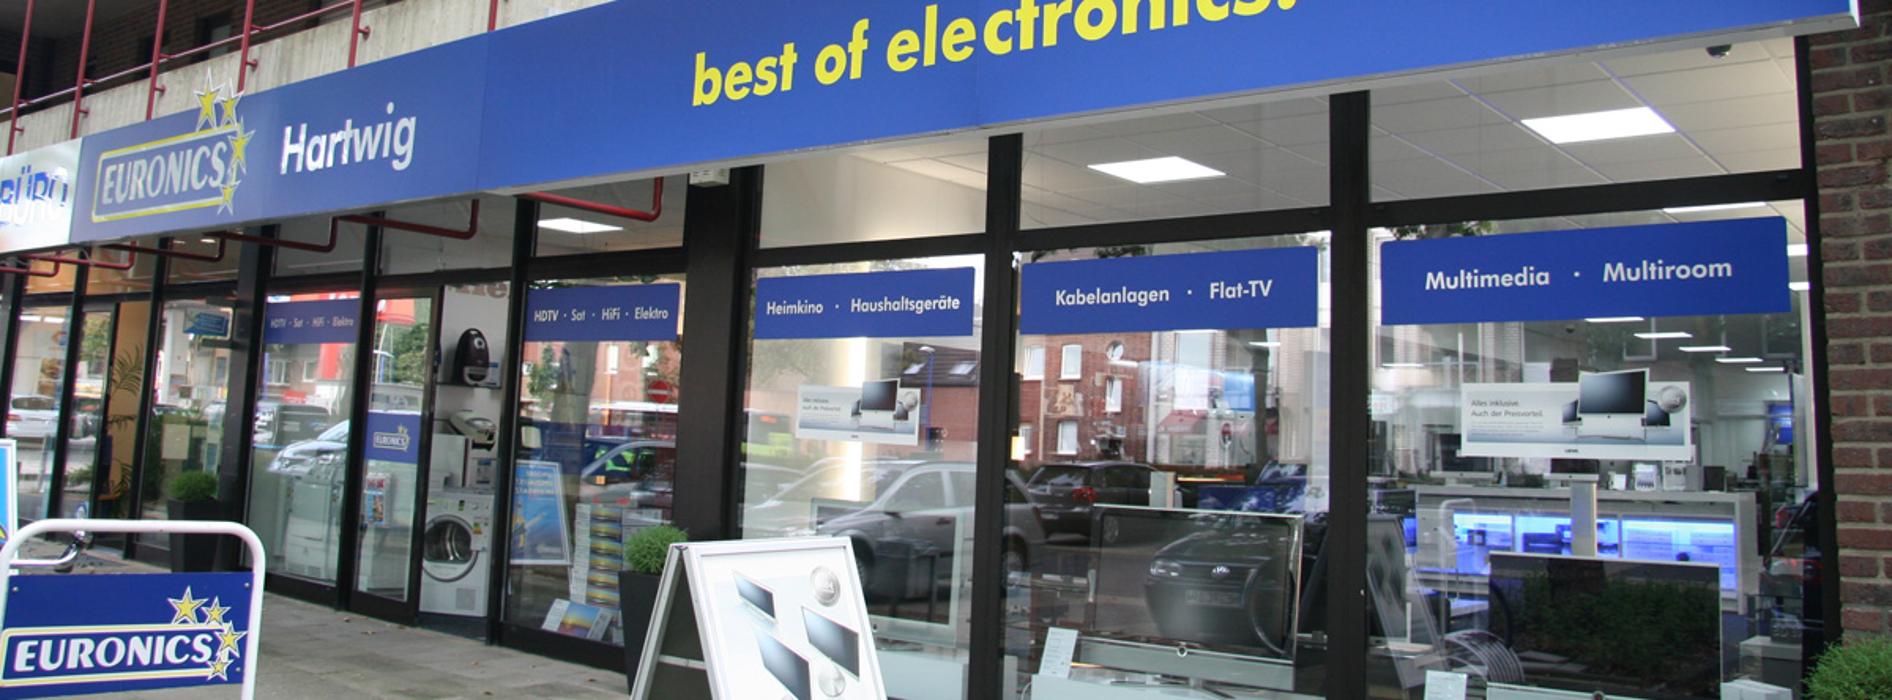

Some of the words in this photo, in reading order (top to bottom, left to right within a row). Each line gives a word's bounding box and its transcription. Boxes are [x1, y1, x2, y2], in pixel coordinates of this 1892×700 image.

[692, 42, 798, 107] best
[814, 18, 869, 86] of
[280, 102, 416, 175] Hartwig
[101, 140, 228, 206] EURONICS
[1425, 266, 1550, 291] Multimedia
[1602, 257, 1733, 283] Multiroom
[766, 300, 824, 316] Heimkino
[850, 294, 961, 315] Haushaltsgeräte
[1055, 286, 1170, 309] Kabelanlagen
[1209, 279, 1273, 300] Flat-TV
[533, 309, 559, 323] HDTV
[571, 309, 586, 322] Sat
[601, 307, 621, 321] HiFi
[634, 306, 669, 321] Elektro
[14, 634, 212, 672] EURONICS
